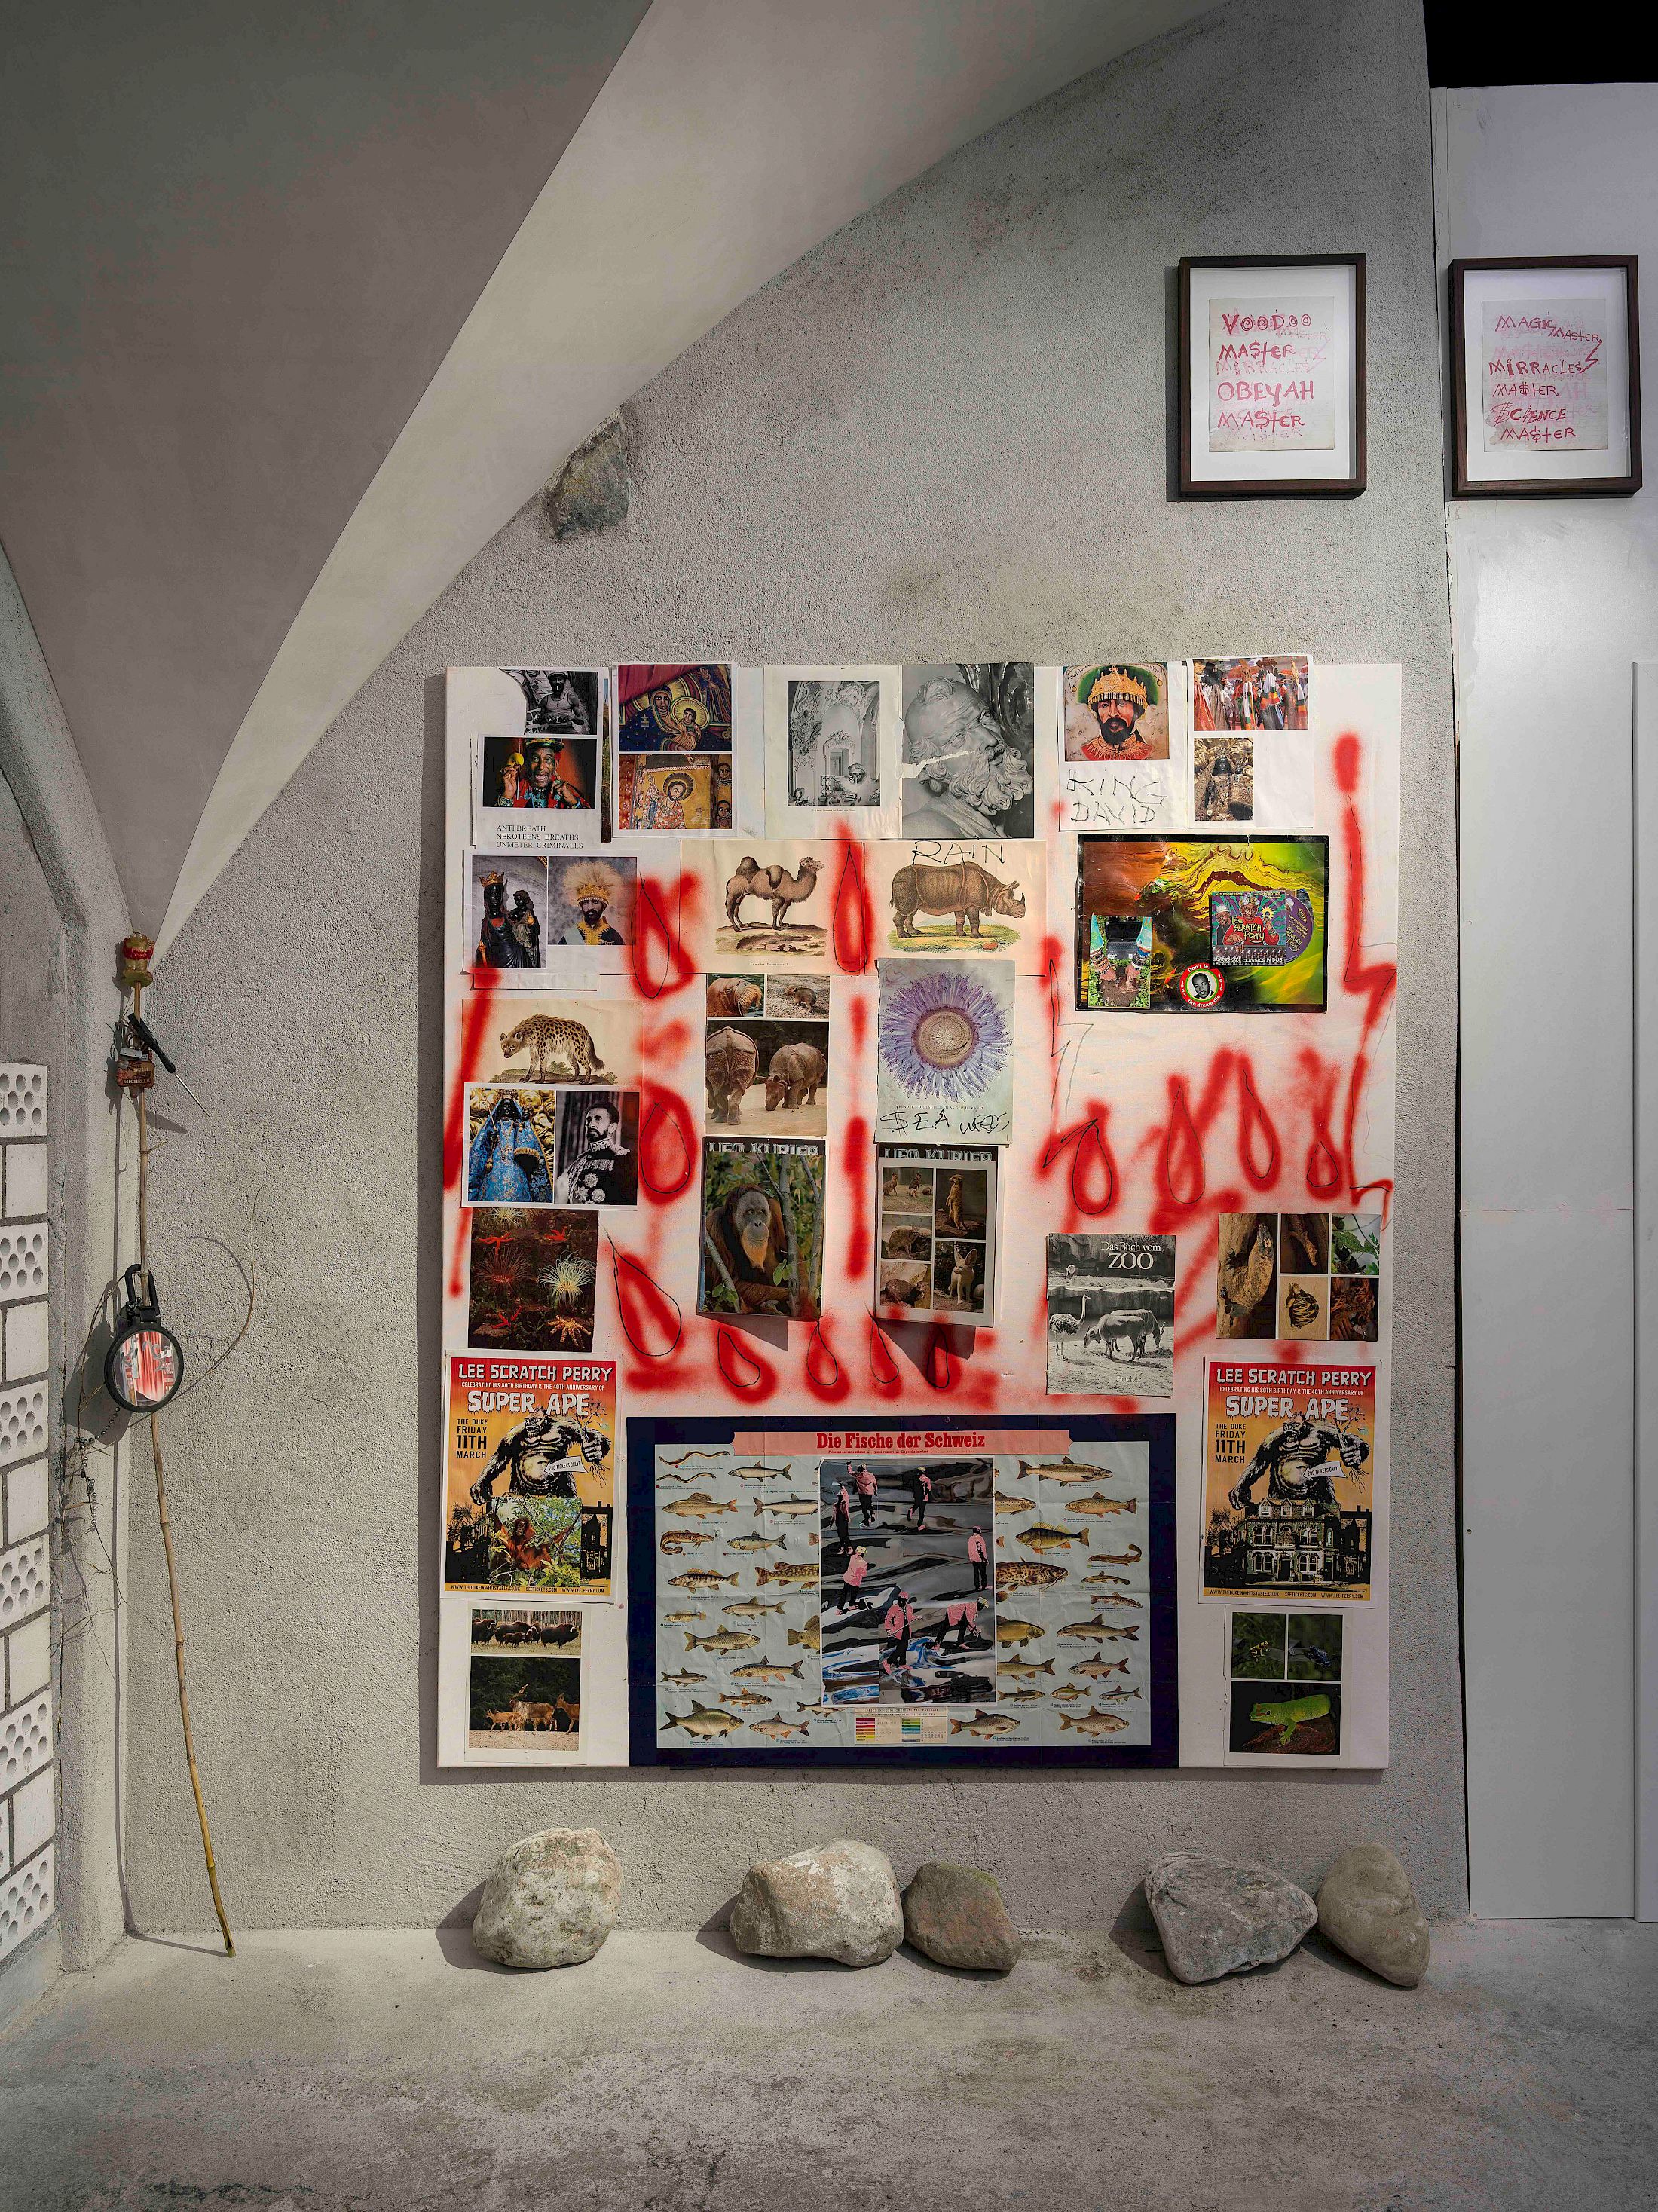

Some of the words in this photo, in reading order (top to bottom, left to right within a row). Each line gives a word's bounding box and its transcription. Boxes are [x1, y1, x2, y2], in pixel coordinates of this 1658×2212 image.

[1222, 314, 1311, 335] VOODOO
[1495, 316, 1556, 332] MAGIC
[1217, 381, 1314, 407] OBEYAH
[1066, 769, 1167, 809] KING
[1071, 801, 1156, 825] DAVID
[912, 840, 1005, 866] RAIN
[1187, 964, 1202, 973] Don't
[1101, 1241, 1118, 1251] Das
[1120, 1241, 1140, 1251] Buch
[1107, 1252, 1154, 1270] ZOO
[458, 1364, 485, 1378] LEE
[490, 1364, 556, 1381] SCRATCH
[562, 1366, 612, 1381] PERRY
[1116, 1375, 1142, 1383] Bucher
[1216, 1368, 1244, 1383] LEE
[1248, 1369, 1316, 1386] SCRATCH
[1321, 1371, 1372, 1386] PERRY
[467, 1391, 535, 1414] SUPER
[546, 1392, 590, 1415] APE
[1225, 1395, 1294, 1418] SUPER
[1305, 1397, 1350, 1420] APE
[457, 1426, 488, 1434] FRIDAY
[1215, 1430, 1246, 1439] FRIDAY
[457, 1435, 487, 1449] 11TH
[816, 1433, 842, 1449] Die
[845, 1433, 893, 1449] Fische
[896, 1432, 922, 1448] der
[925, 1432, 985, 1448] Schweiz
[1216, 1439, 1246, 1454] 11TH
[556, 1462, 571, 1470] TICKETS
[1215, 1455, 1245, 1464] MARCH
